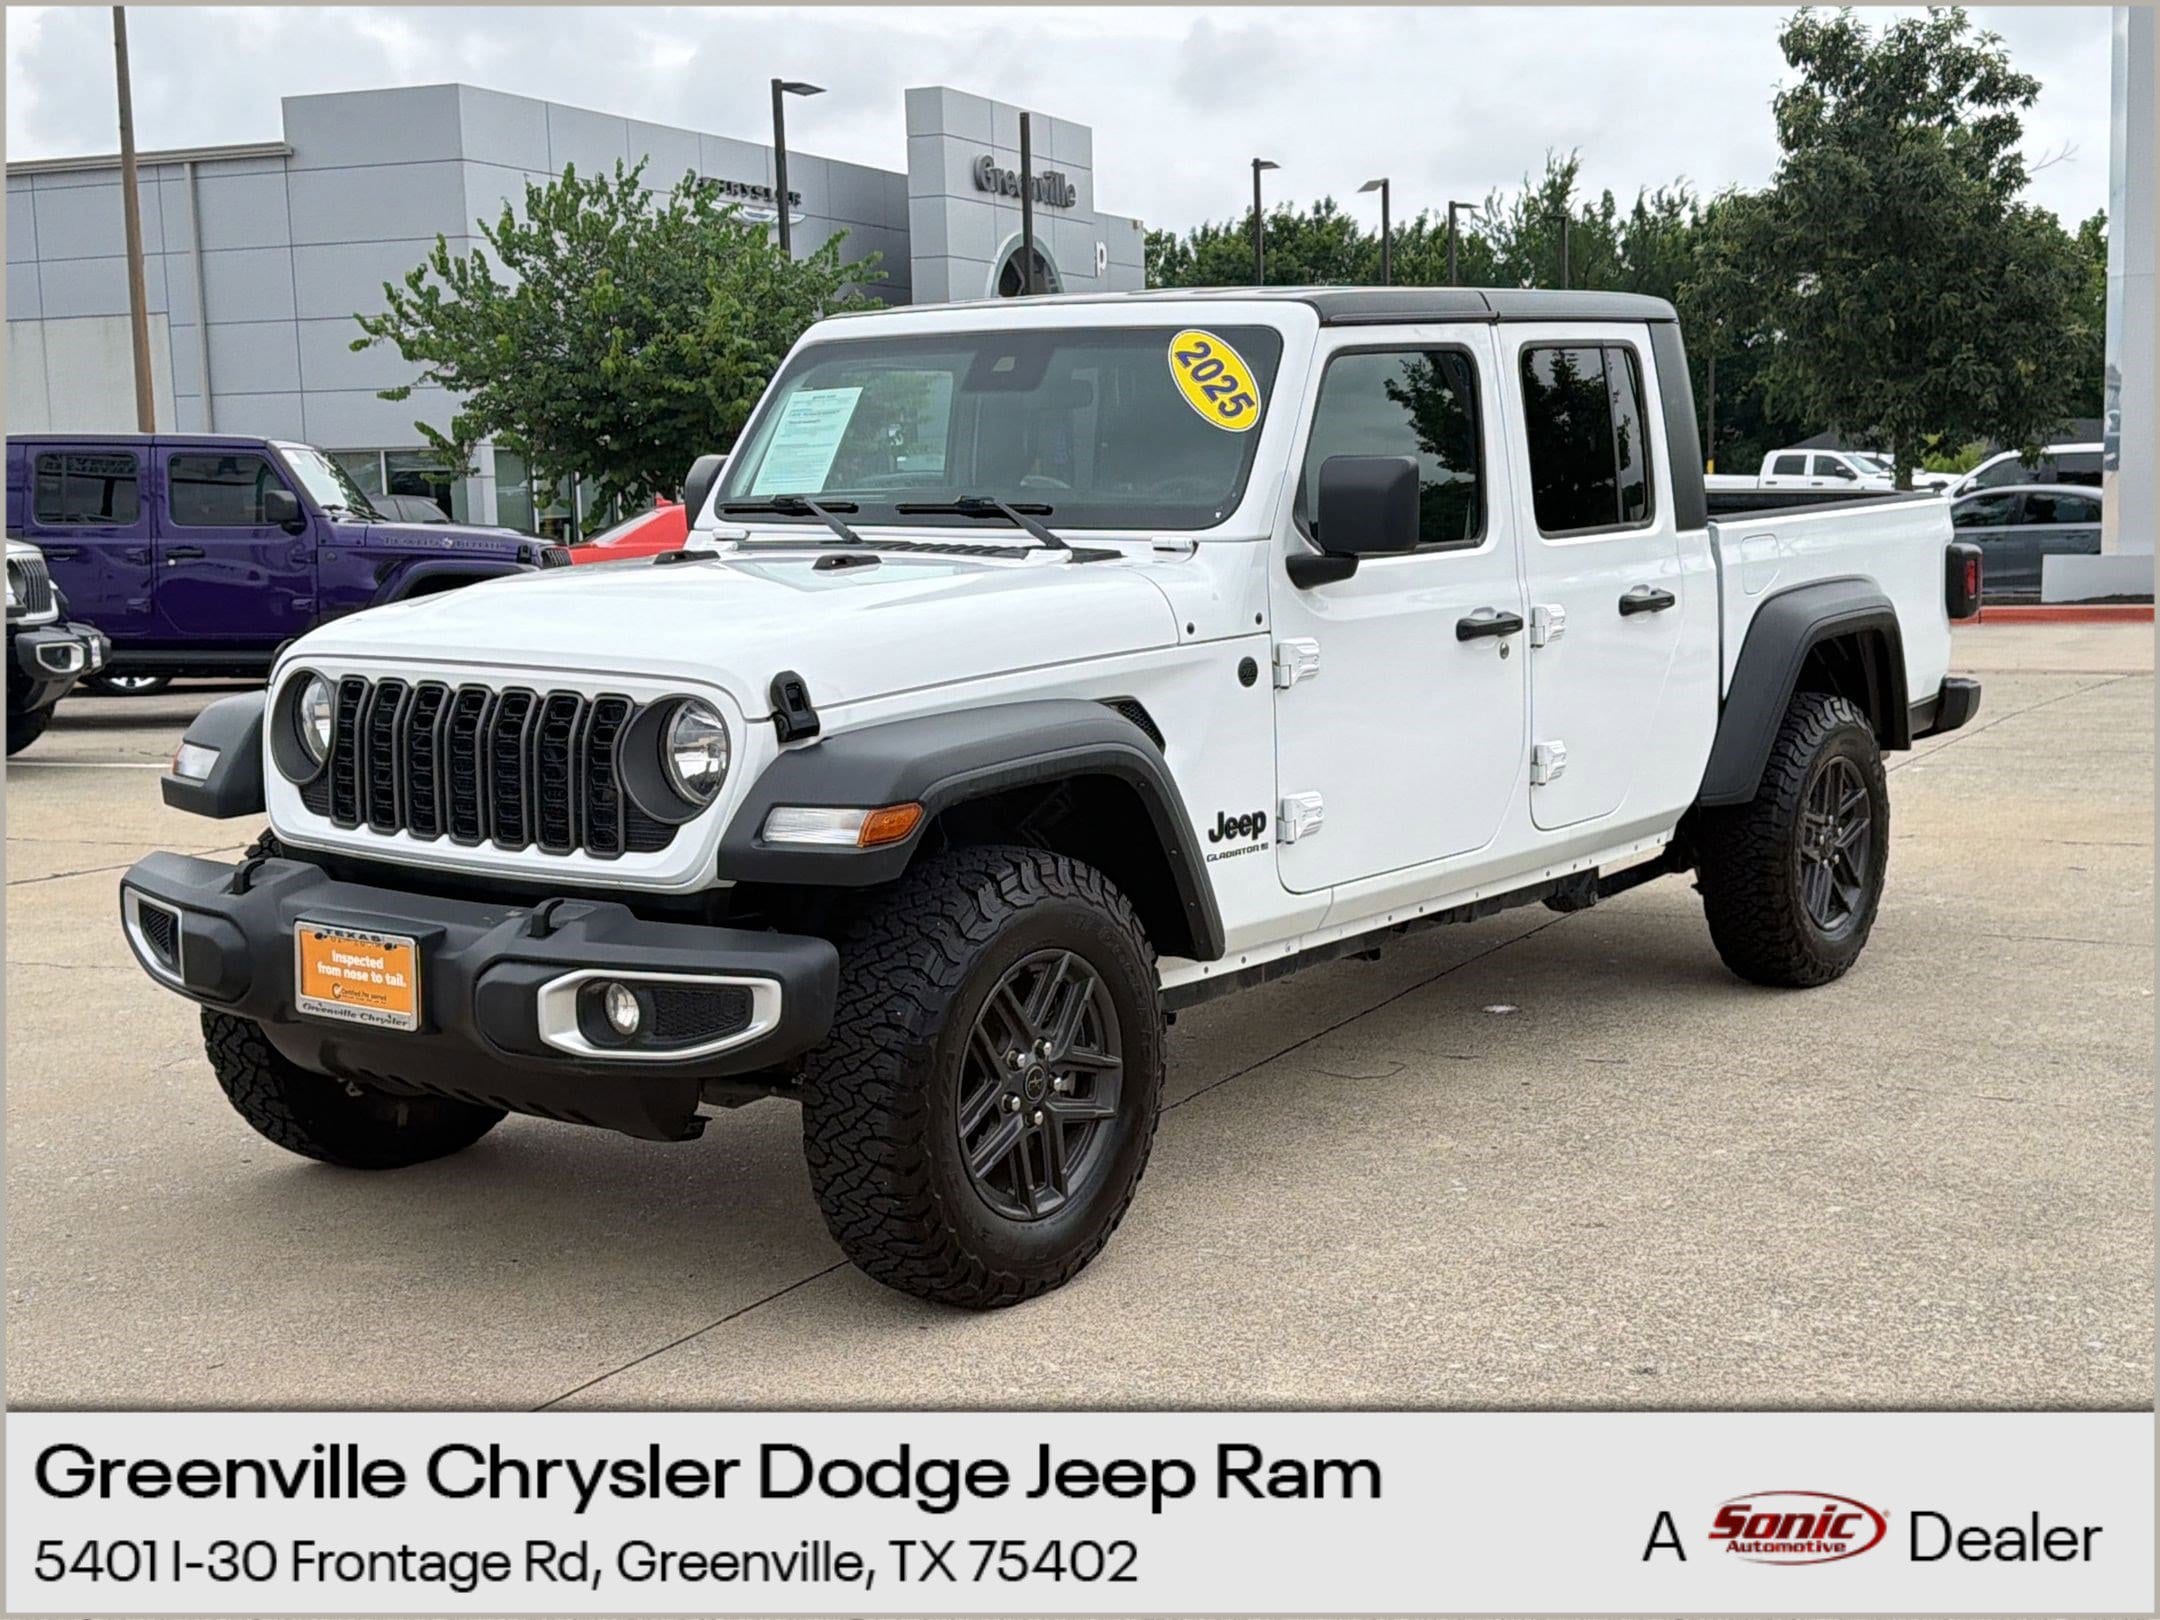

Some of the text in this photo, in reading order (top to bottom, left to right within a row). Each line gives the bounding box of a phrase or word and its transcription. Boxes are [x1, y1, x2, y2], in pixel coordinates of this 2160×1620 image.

[1175, 341, 1255, 418] 2025
[1208, 811, 1267, 843] Jeep
[1206, 844, 1260, 862] GLADIATOR
[325, 928, 382, 942] TEXAS
[331, 949, 384, 970] Inspected
[317, 961, 407, 987] from nose to tail.
[302, 1002, 408, 1027] Greenville Chrysler
